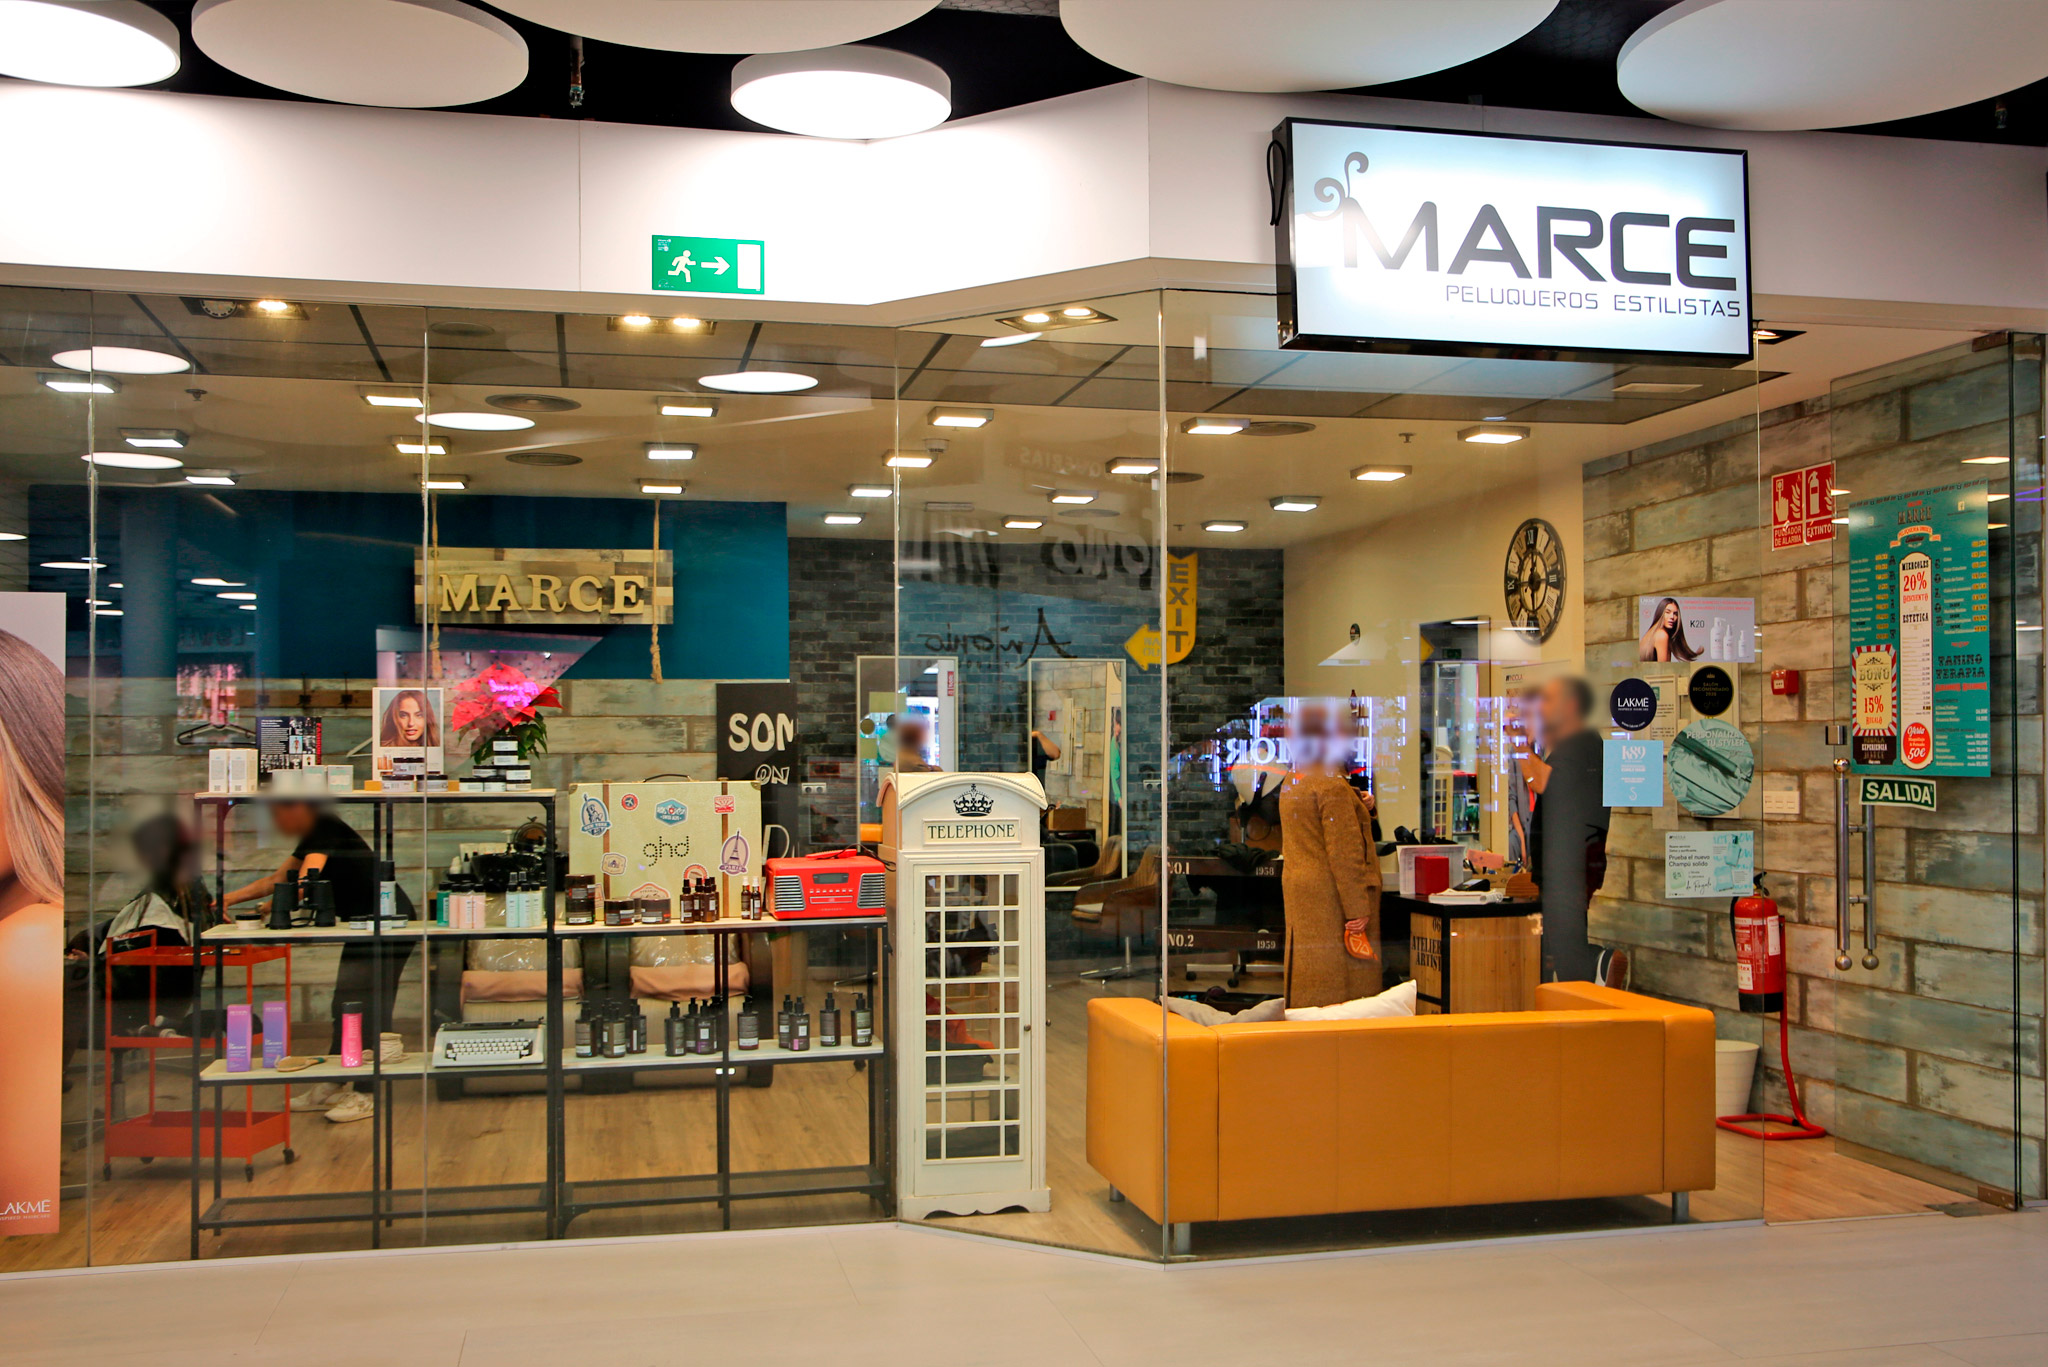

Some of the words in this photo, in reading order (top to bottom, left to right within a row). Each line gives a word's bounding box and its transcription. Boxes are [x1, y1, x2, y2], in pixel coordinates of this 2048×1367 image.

[1342, 196, 1737, 291] MARCE
[1446, 285, 1598, 311] PELUQUEROS
[1614, 294, 1741, 318] ESTILISTAS
[1806, 522, 1834, 537] EXTINTO
[1774, 538, 1782, 547] DE
[1902, 560, 1930, 571] MIERCOLES
[1903, 571, 1927, 592] 20%
[440, 573, 645, 614] MARCE
[1168, 563, 1189, 653] EXIT
[1689, 619, 1705, 628] K20
[1902, 612, 1929, 624] ESTETICA
[1864, 695, 1884, 713] 15%
[1718, 739, 1745, 748] STYLER
[1907, 747, 1926, 760] 50€
[1866, 781, 1932, 805] SALIDA
[927, 824, 1016, 839] TELEPHONE
[643, 836, 690, 867] ghd
[1255, 866, 1275, 876] 1958
[1257, 940, 1276, 949] 1959
